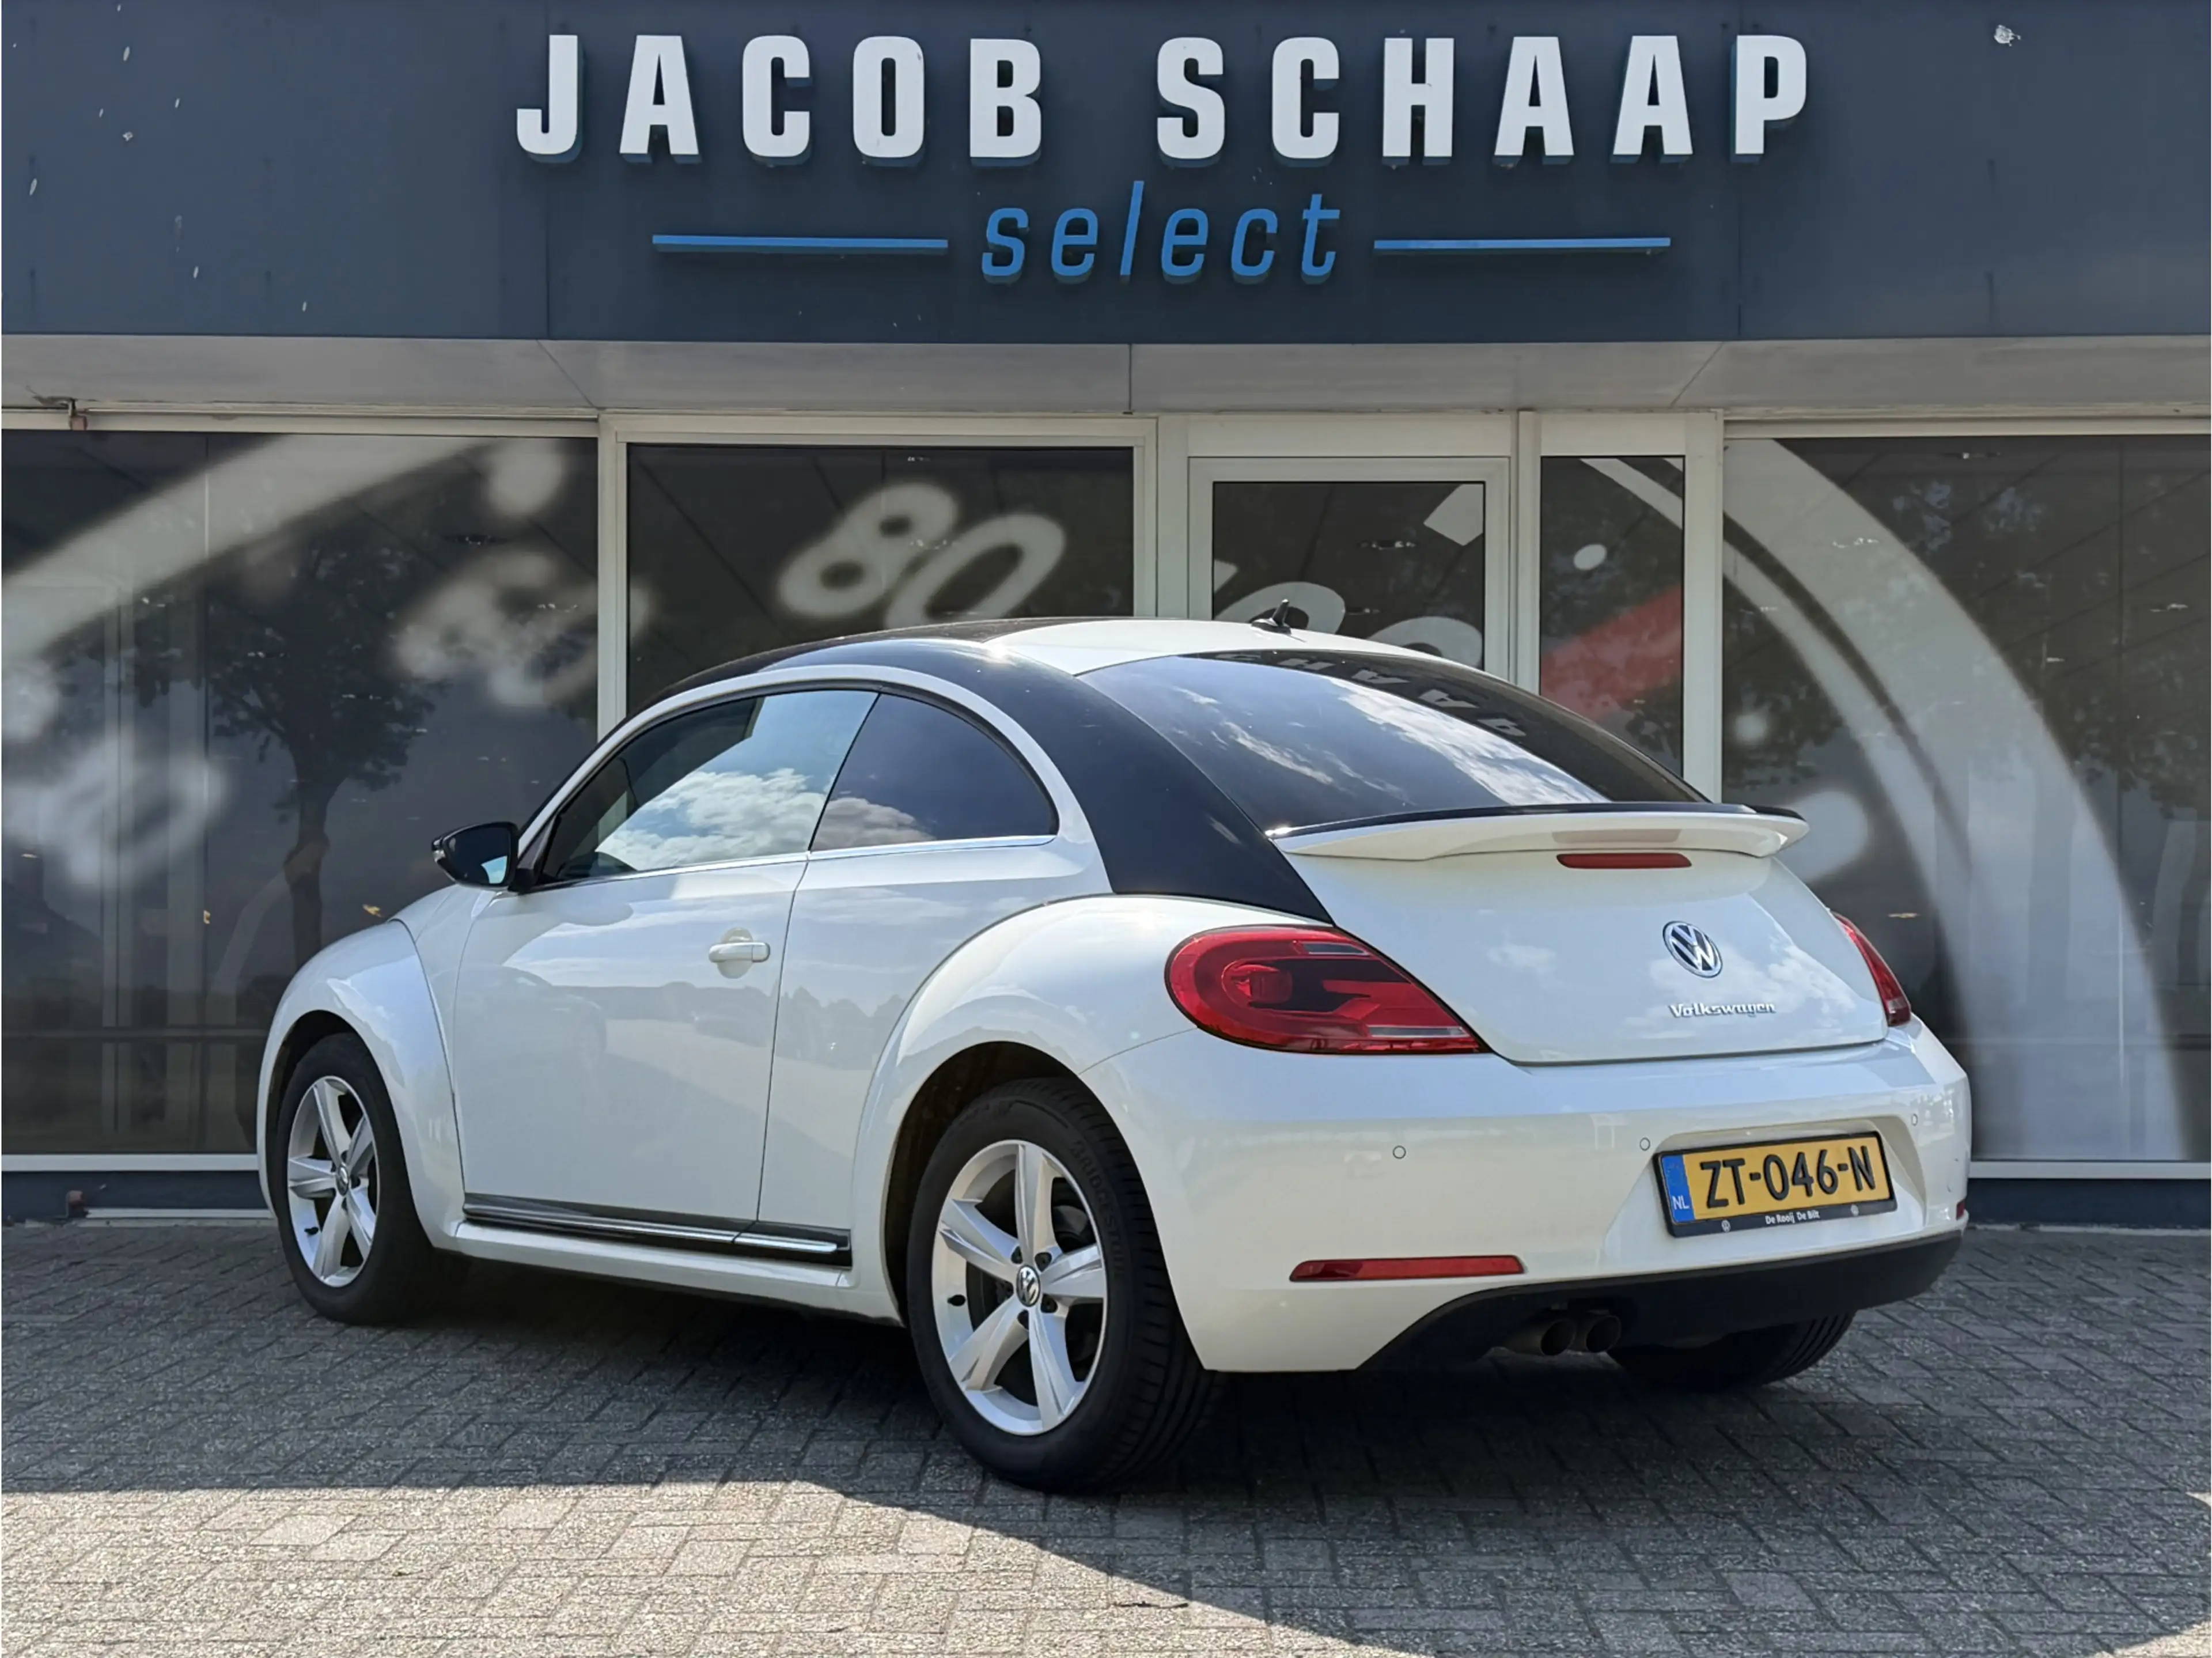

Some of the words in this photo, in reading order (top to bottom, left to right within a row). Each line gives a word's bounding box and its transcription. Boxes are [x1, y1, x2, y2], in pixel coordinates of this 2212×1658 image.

[516, 35, 1041, 159] JACOB
[1156, 35, 1806, 160] SCHAAP
[981, 180, 1340, 278] select
[778, 482, 1067, 630] 80
[1668, 1002, 1777, 1018] Volkswagen
[1672, 1195, 1690, 1210] NL
[1699, 1145, 1876, 1209] ZT-046-N
[1764, 1215, 1776, 1225] De
[1796, 1211, 1806, 1221] De
